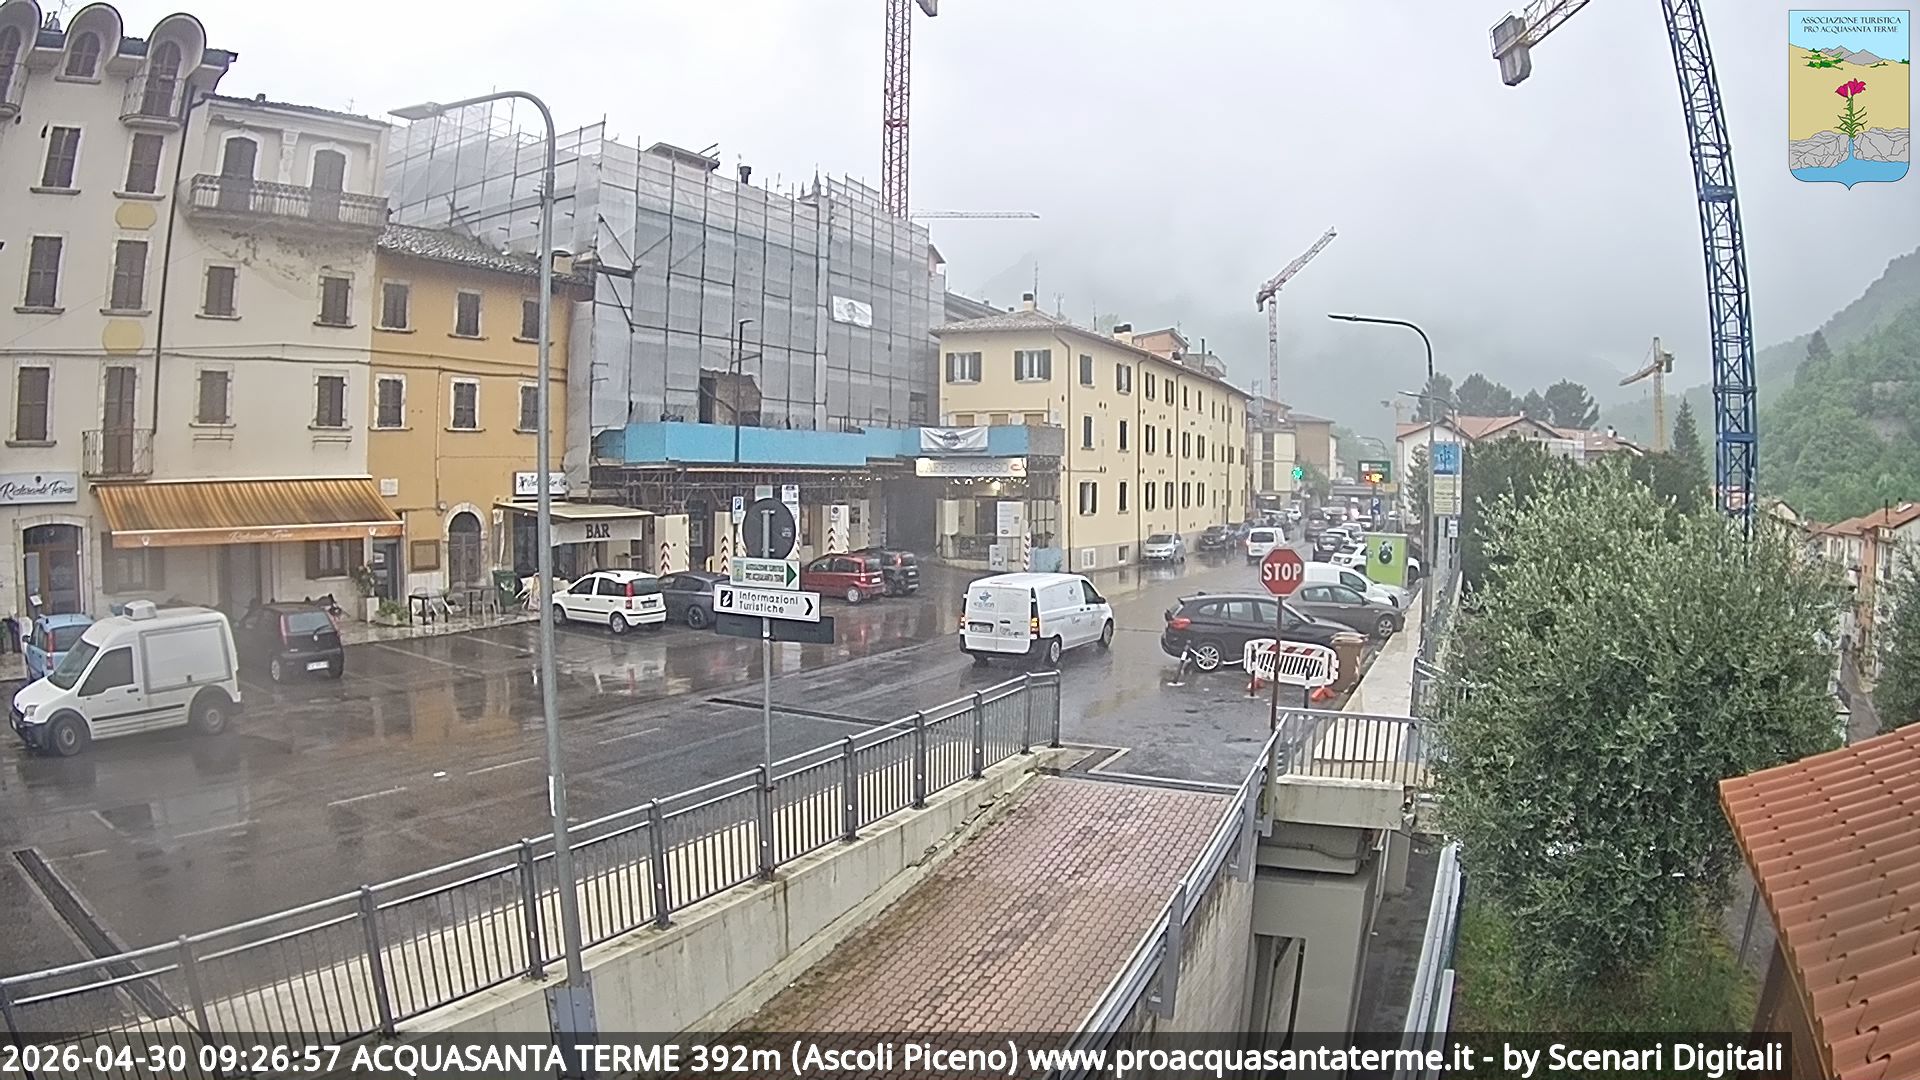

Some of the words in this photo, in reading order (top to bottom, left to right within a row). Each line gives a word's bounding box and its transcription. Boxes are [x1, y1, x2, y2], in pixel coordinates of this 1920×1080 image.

[585, 523, 611, 538] BAR
[1263, 562, 1302, 581] STOP
[739, 591, 799, 605] Informazioni
[739, 600, 784, 614] Turistiche
